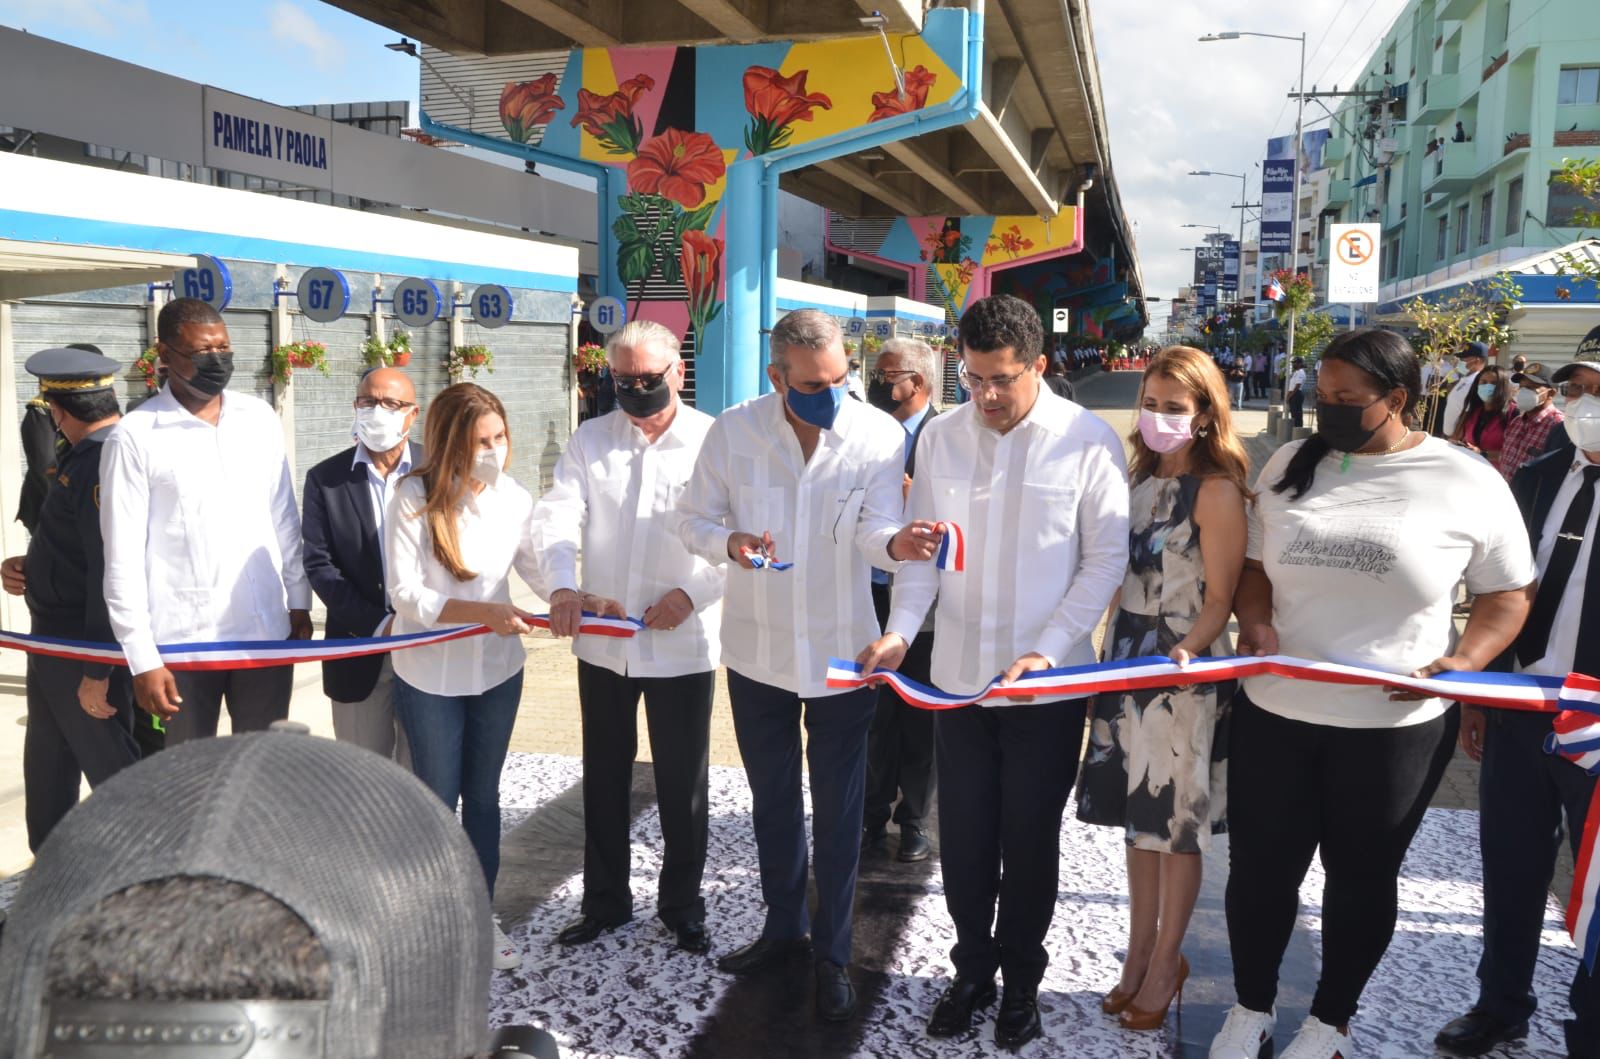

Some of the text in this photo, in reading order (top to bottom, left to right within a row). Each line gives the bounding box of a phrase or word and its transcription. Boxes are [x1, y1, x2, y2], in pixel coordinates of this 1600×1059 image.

[213, 111, 327, 170] PAMELA Y PAOLA
[183, 267, 215, 302] 69
[308, 280, 335, 310] 67
[402, 288, 429, 316] 65
[478, 294, 502, 317] 63
[597, 305, 615, 326] 61
[850, 321, 862, 332] 57
[876, 324, 888, 335] 55
[923, 325, 933, 333] 53
